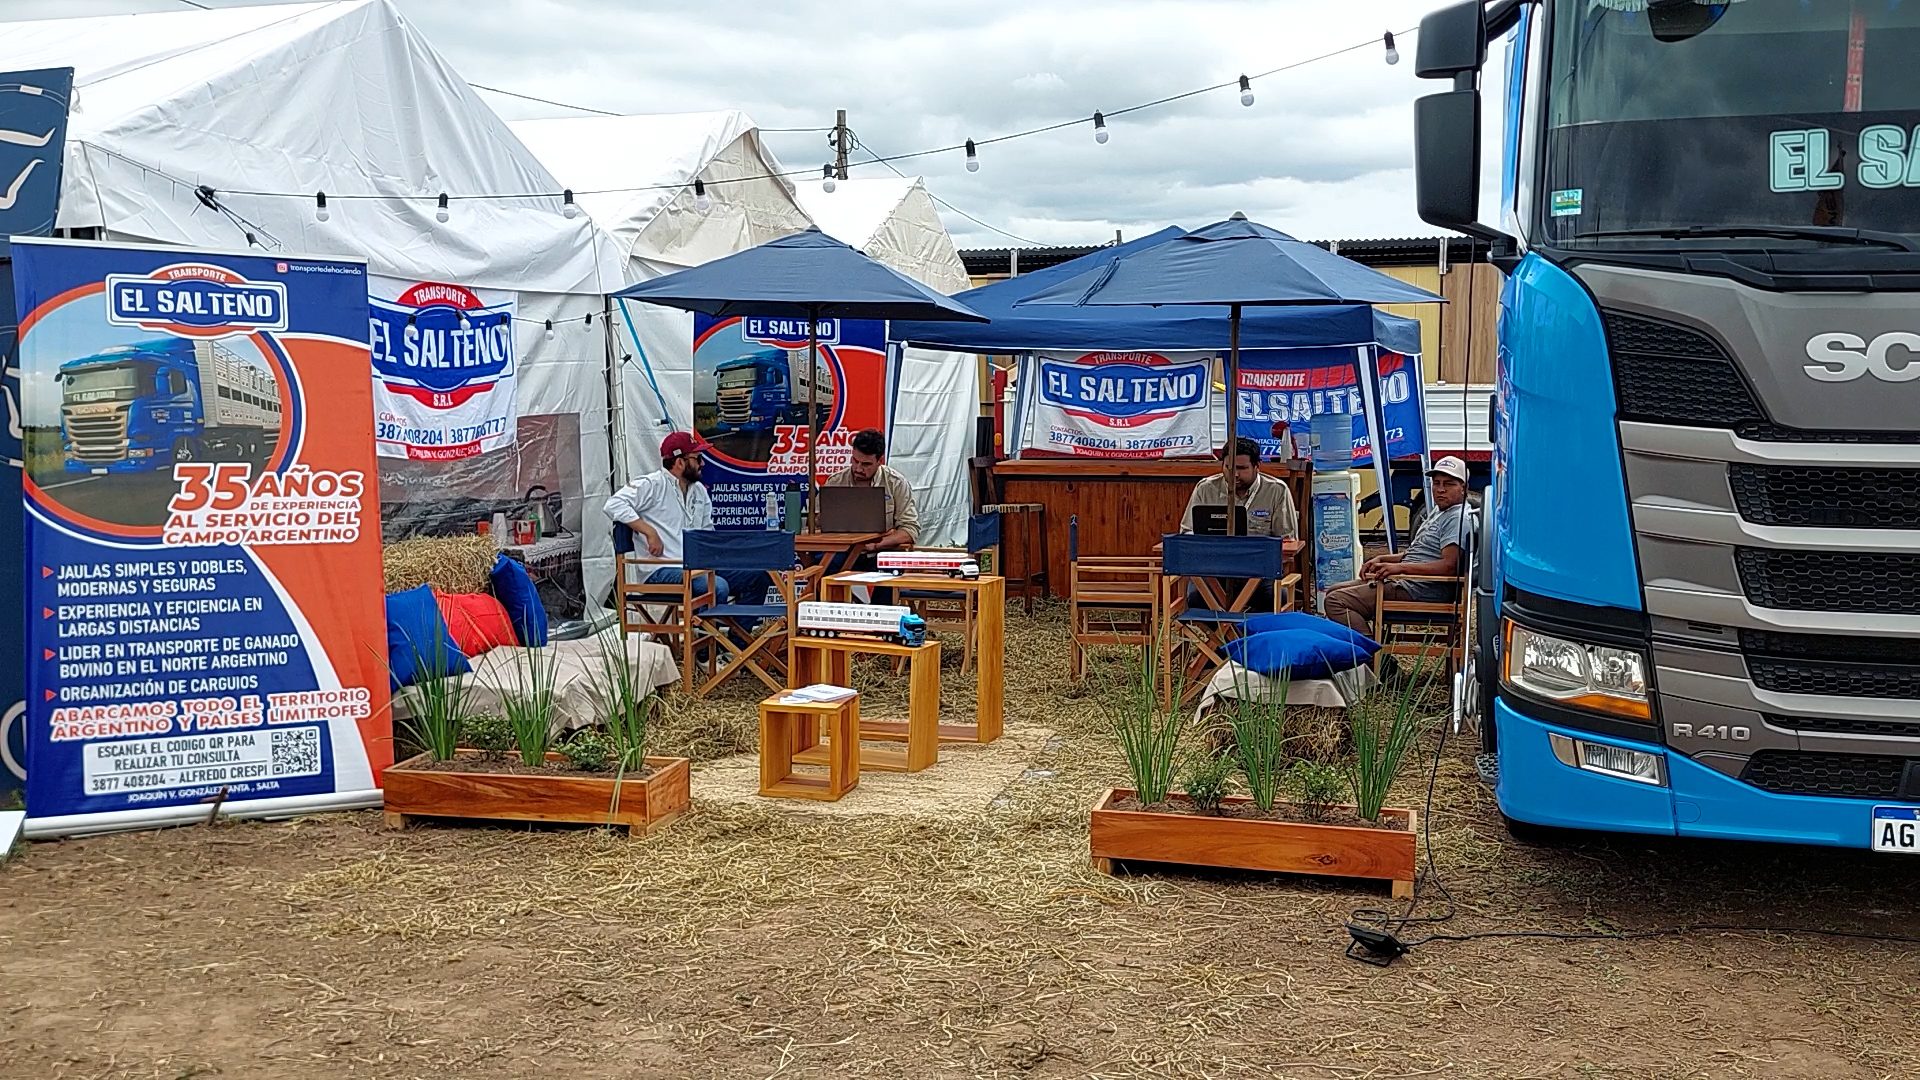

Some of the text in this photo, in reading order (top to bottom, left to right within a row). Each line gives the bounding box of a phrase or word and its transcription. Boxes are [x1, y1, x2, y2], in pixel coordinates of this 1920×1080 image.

[1769, 128, 1845, 193] EL
[168, 267, 228, 282] TRANSPORTE
[290, 265, 362, 274] transportedehacienda
[121, 289, 273, 318] EL SALTEÑO
[413, 286, 467, 307] TRANSPORTE
[749, 320, 765, 334] EL
[369, 318, 509, 368] EL SALTEÑO
[1092, 352, 1153, 365] TRANSPORTE
[1049, 370, 1198, 403] EL SALTEÑO
[1241, 373, 1306, 387] TRANSPORTE
[1109, 418, 1130, 427] S.R.L
[772, 426, 809, 454] 35
[1049, 430, 1194, 449] 3877408204 3877666773
[770, 456, 786, 464] AL
[171, 465, 361, 511] 35 AÑOS
[711, 484, 739, 492] JAULAS
[741, 484, 773, 492] SIMPLES
[711, 494, 753, 502] MODERNAS
[250, 501, 359, 511] DE EXPERIENCIA
[712, 507, 761, 515] EXPERIENCIA
[167, 512, 357, 528] AL SERVICIO DEL
[711, 517, 741, 525] LARGAS
[166, 528, 358, 545] CAMPO ARGENTINO
[57, 559, 248, 580] JAULAS SIMPLES Y DOBLES,
[58, 577, 216, 598] MODERNAS Y SEGURAS
[58, 597, 263, 620] EXPERIENCIA Y EFICIENCIA EN
[58, 617, 201, 638] LARGAS DISTANCIAS
[59, 633, 299, 661] LIDER EN TRANSPORTE DE GANADO
[59, 651, 288, 679] BOVINO EN EL NORTE ARGENTINO
[60, 675, 259, 702] ORGANIZACIÓN DE CARGUIOS
[53, 689, 368, 724] ABARCAMOS TODO EL TERRITORIO
[52, 703, 370, 740] ARGENTINO Y PAISES LIMITROFES
[1673, 723, 1750, 741] R 410
[98, 734, 255, 758] ESCANEA EL CODIGO QR PARA
[115, 750, 240, 771] REALIZAR TU CONSULTA
[92, 777, 119, 791] 3877
[123, 774, 166, 789] 408204
[179, 768, 226, 784] ALFREDO
[230, 764, 268, 778] CRESPI
[256, 781, 280, 790] SALTA
[1881, 822, 1915, 848] AG
